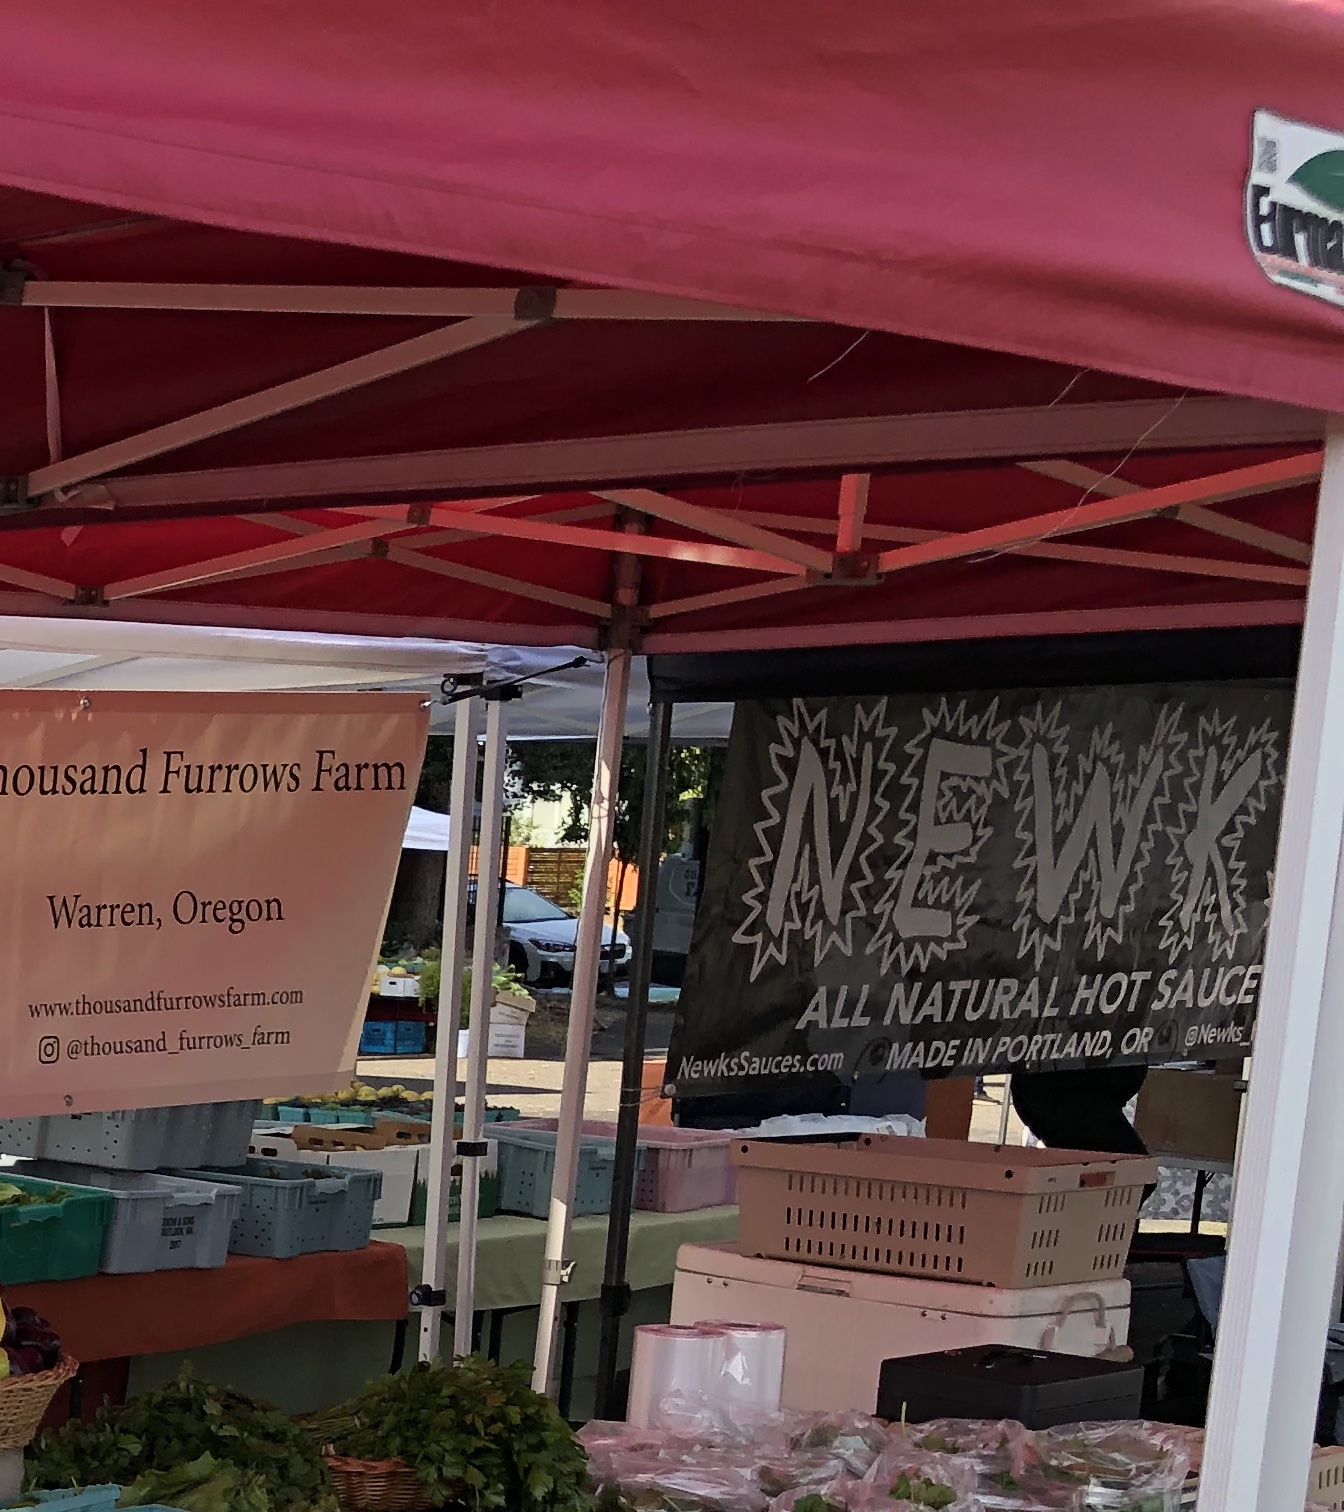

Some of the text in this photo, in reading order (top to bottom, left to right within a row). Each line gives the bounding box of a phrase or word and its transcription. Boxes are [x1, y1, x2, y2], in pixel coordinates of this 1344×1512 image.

[158, 750, 302, 795] Furrows
[310, 749, 407, 792] Farm
[47, 890, 285, 934] Warren, Oregon
[28, 987, 303, 1018] www.thousandfurrowsfarm.com
[795, 964, 1263, 1030] ALL NATURAL HOT SAUCE
[66, 1025, 291, 1060] @thousand_furrows_farm
[885, 1026, 1154, 1070] MADE IN PORTLAND, OR
[677, 1051, 844, 1080] NewksSauces.com
